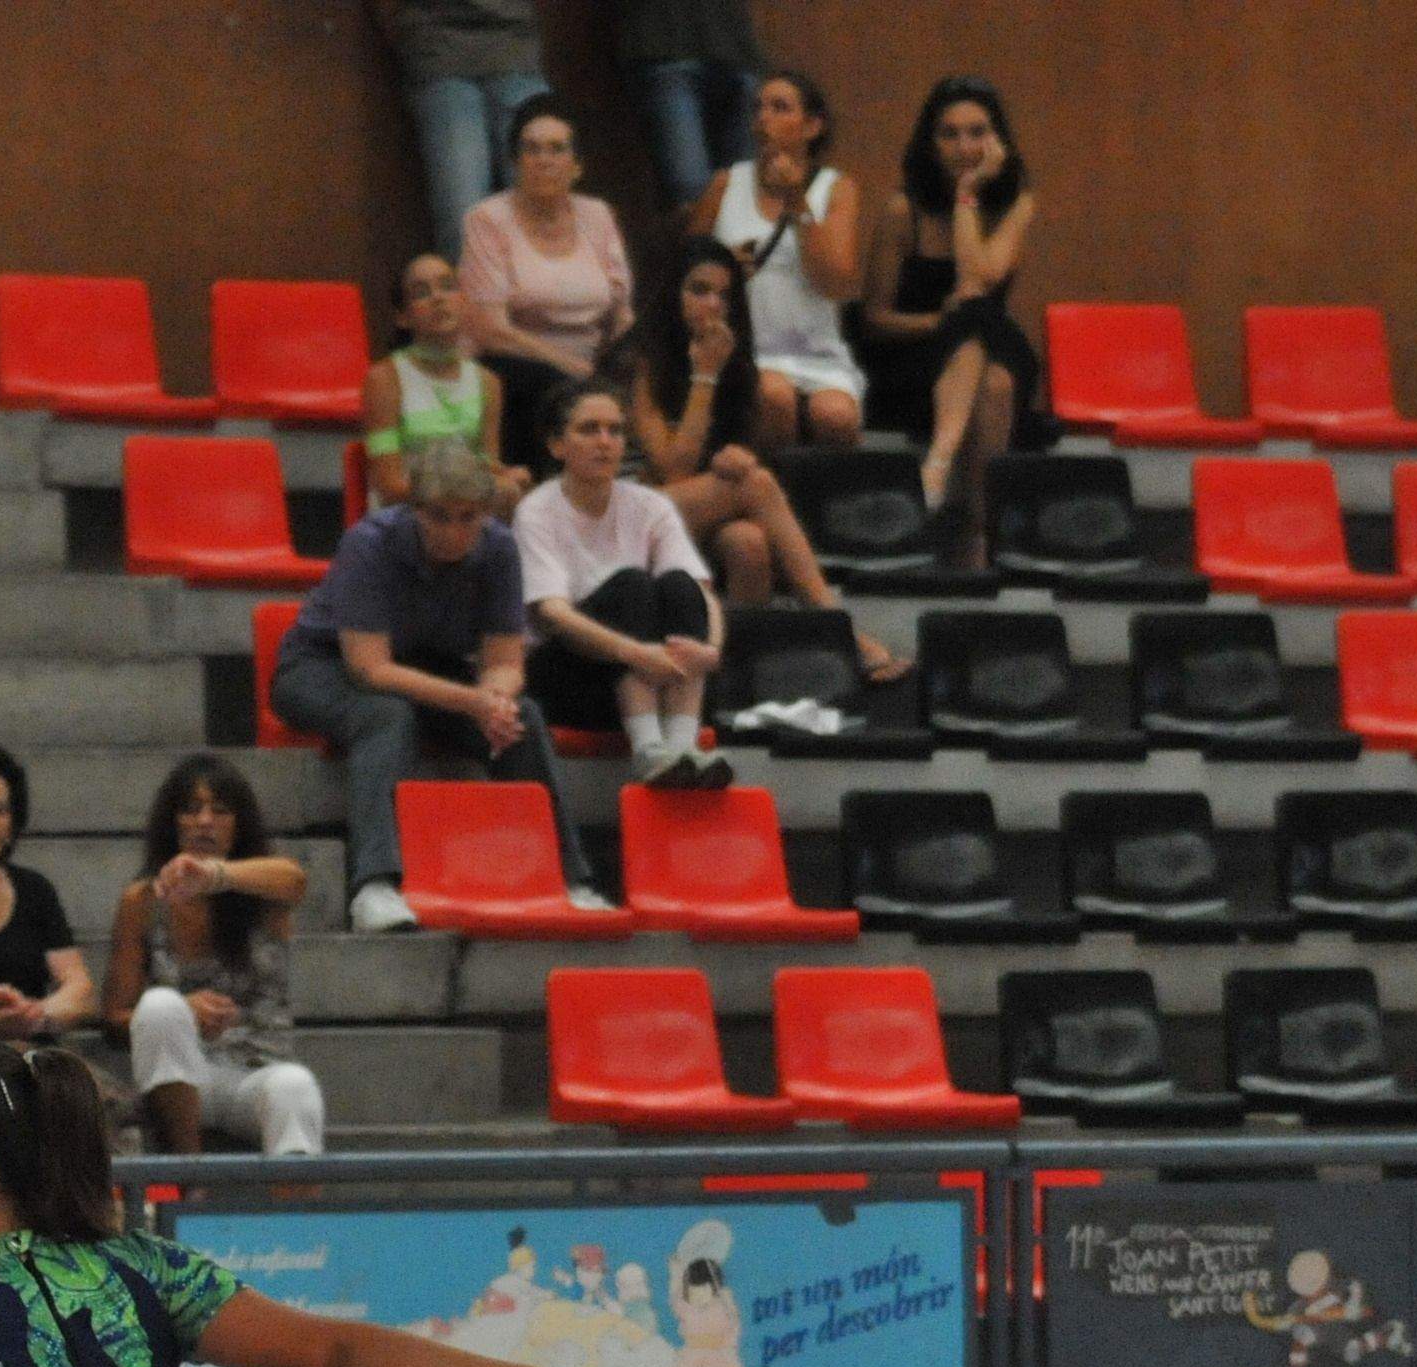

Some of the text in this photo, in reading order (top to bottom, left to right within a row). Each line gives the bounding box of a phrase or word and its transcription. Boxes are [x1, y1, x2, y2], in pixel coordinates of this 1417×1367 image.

[801, 1277, 843, 1306] un
[852, 1244, 922, 1293] món
[815, 1277, 954, 1344] descobrir
